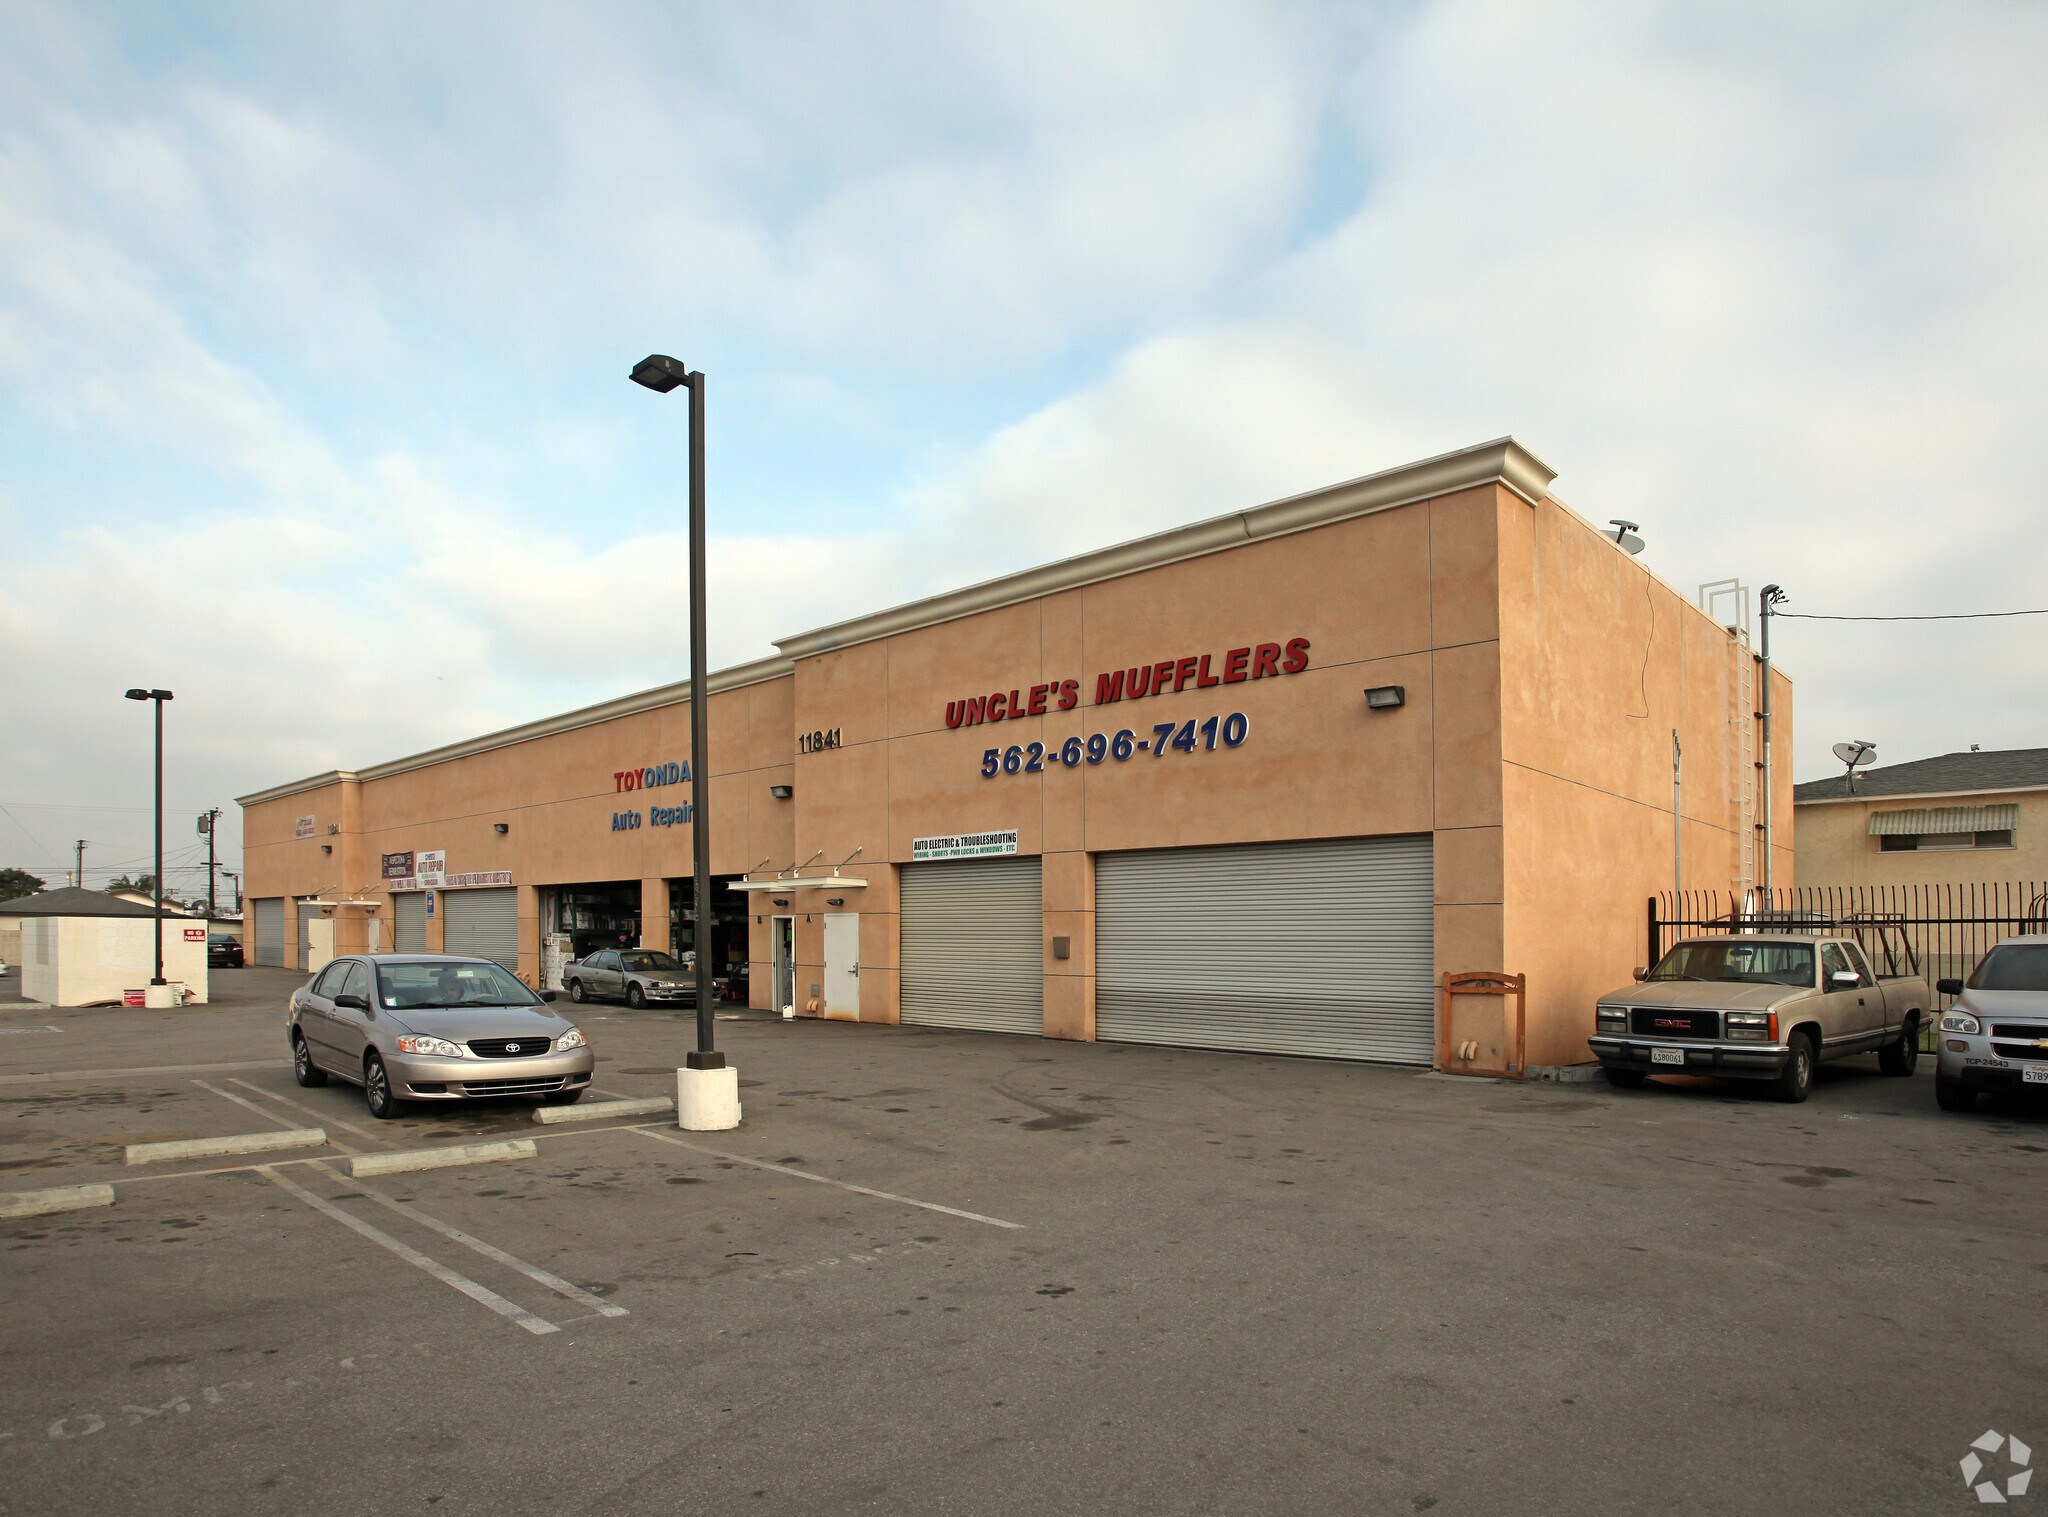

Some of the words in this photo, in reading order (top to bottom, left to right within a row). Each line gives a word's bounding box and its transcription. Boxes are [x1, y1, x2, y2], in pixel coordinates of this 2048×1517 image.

[945, 679, 1079, 729] UNCLE'S
[1094, 637, 1311, 705] MUFFLERS
[799, 728, 842, 752] 11841
[981, 712, 1250, 778] 562-696-7410
[614, 760, 691, 793] TOYONDA
[612, 809, 641, 831] Auto
[650, 799, 693, 828] Repair
[913, 840, 928, 851] AUTO
[929, 837, 955, 849] ELECTRIC
[956, 839, 960, 847] &
[960, 832, 1017, 847] TROUBLESHOOTING
[913, 851, 929, 859] WIRING
[961, 847, 975, 855] LOCKS
[979, 845, 1003, 853] WINDOWS
[417, 861, 427, 873] AUTO
[428, 860, 444, 872] REPAIR
[1654, 1018, 1691, 1029] GMC
[1964, 1057, 2009, 1068] TCP-24543
